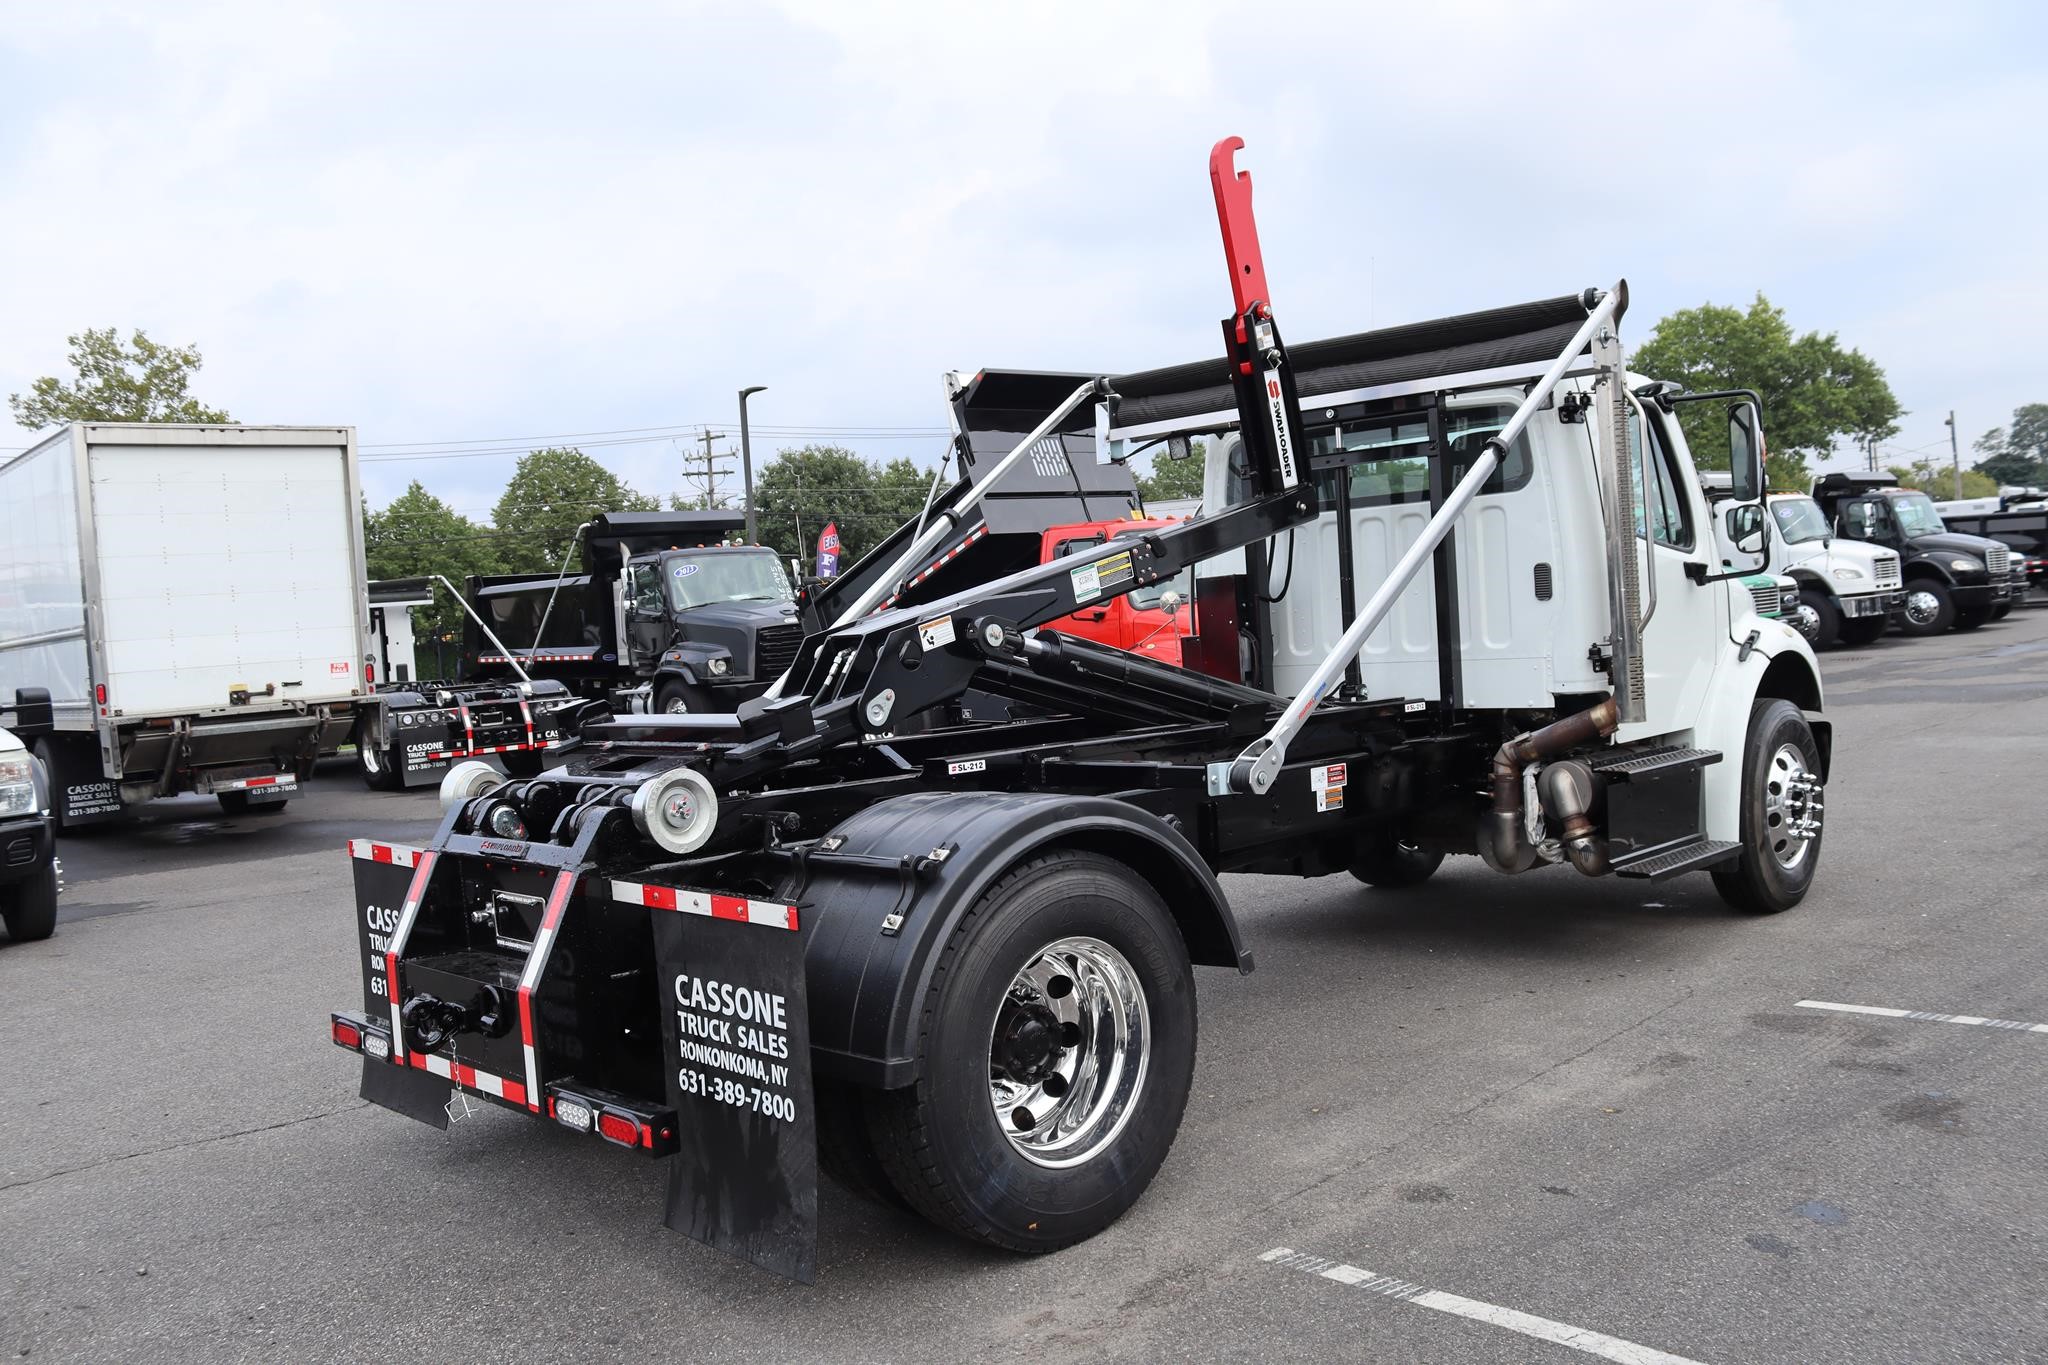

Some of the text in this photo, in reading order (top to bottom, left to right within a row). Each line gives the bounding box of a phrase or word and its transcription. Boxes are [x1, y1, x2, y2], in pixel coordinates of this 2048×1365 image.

[1273, 401, 1292, 478] SWAPLOADER
[406, 741, 444, 752] CASSONE
[407, 751, 426, 759] TRUCK
[958, 762, 983, 772] SL-212
[67, 782, 111, 795] CASSON
[68, 794, 93, 802] TRUCK
[675, 974, 787, 1030] CASSONE
[677, 1010, 789, 1060] TRUCK SALES
[679, 1039, 789, 1087] RONKONKOMA, NY
[678, 1068, 795, 1123] 631-389-7800
